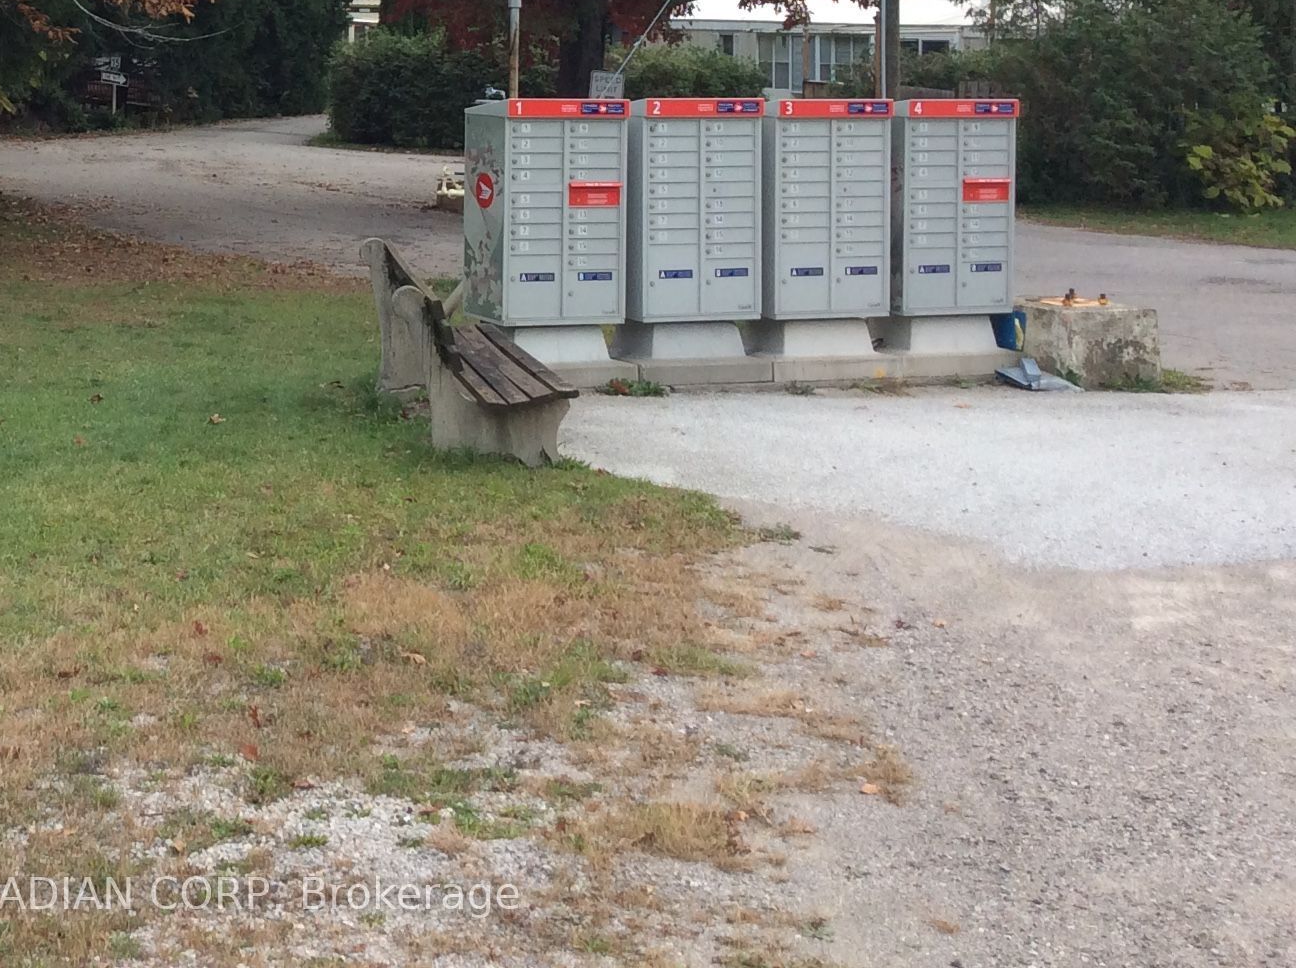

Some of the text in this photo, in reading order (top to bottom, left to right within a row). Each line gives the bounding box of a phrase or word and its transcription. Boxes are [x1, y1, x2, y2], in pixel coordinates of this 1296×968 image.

[515, 101, 522, 115] 1
[652, 101, 661, 115] 2
[784, 101, 793, 115] 3
[914, 102, 922, 115] 4
